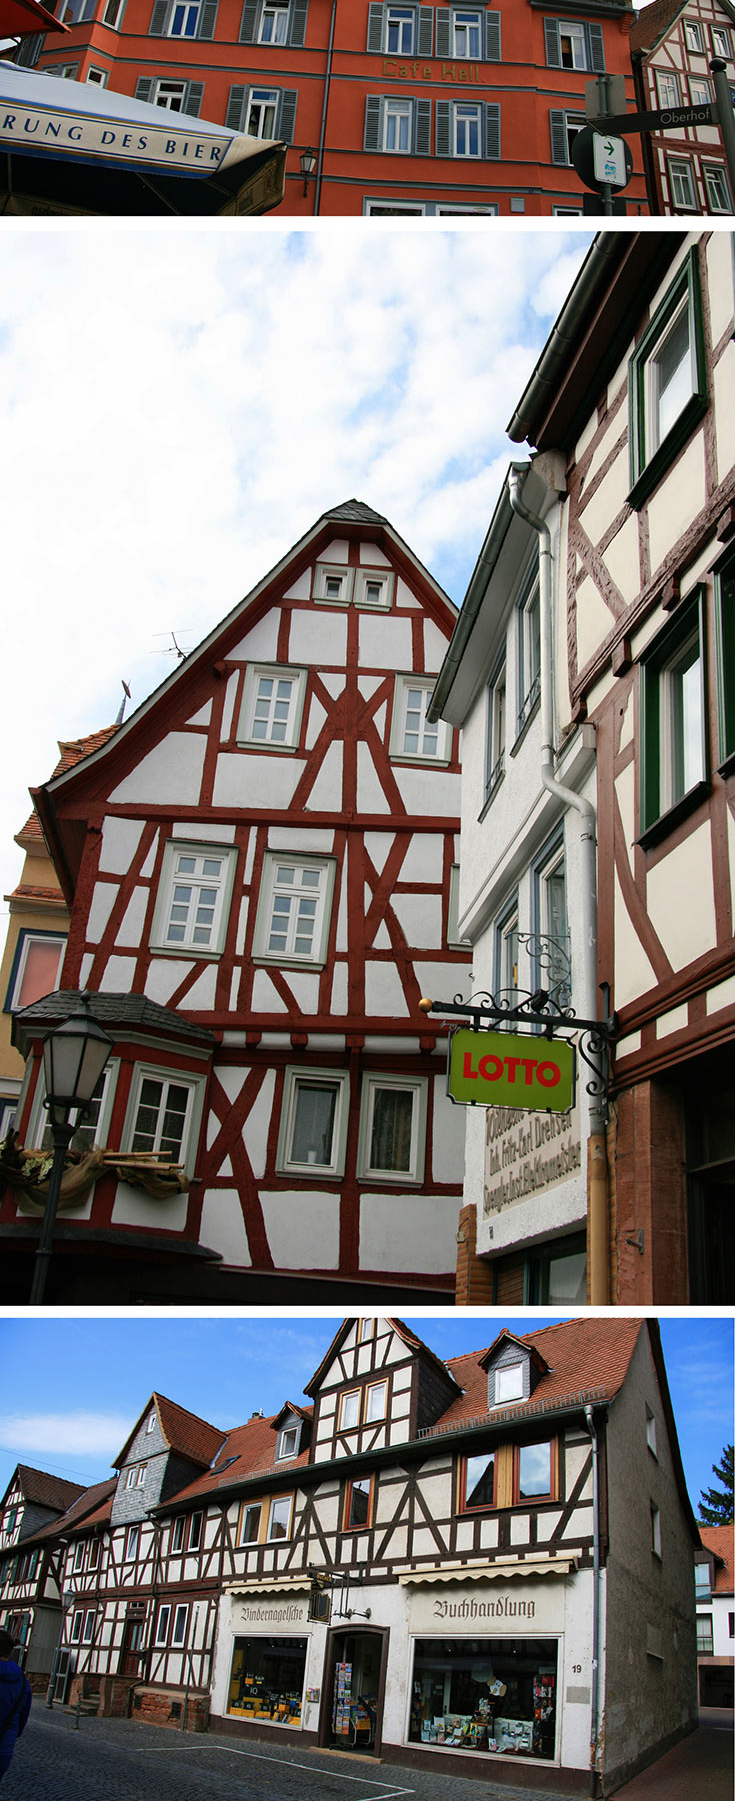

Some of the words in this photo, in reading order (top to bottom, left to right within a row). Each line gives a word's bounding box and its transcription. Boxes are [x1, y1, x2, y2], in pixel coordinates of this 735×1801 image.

[382, 59, 432, 79] Cafe
[660, 107, 711, 125] Oberhof
[2, 114, 84, 141] RUNG
[101, 130, 148, 151] DES
[165, 140, 222, 162] BIER
[463, 1052, 562, 1088] LOTTO
[433, 1596, 536, 1621] Buchhandlung
[571, 1665, 582, 1674] 19
